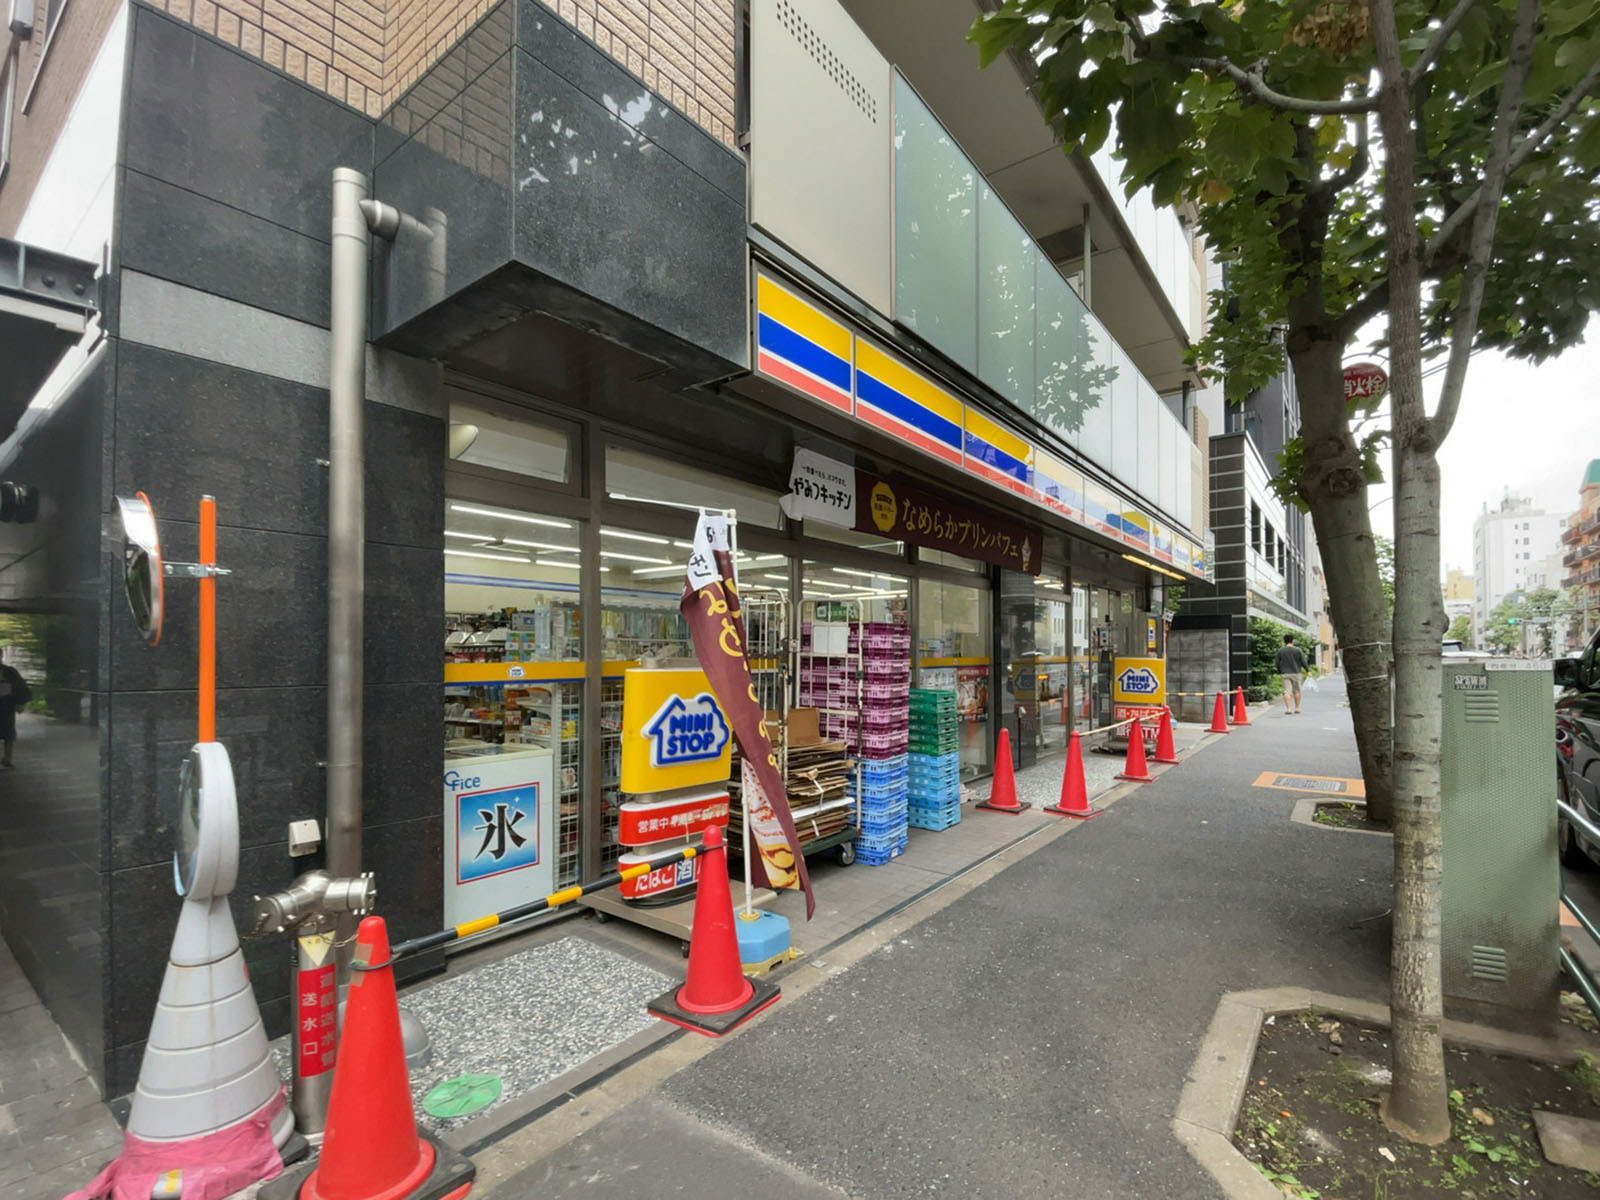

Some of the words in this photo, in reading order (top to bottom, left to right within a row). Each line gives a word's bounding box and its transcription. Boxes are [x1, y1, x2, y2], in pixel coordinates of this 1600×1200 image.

[793, 477, 852, 511] やみつキッチン
[902, 498, 1019, 557] なめらかプリンパフェ
[1125, 682, 1150, 690] STOP
[1126, 674, 1150, 683] MINI
[668, 712, 714, 735] MINI
[666, 732, 716, 756] STOP
[474, 804, 528, 861] 氷
[301, 993, 319, 1056] 送水口
